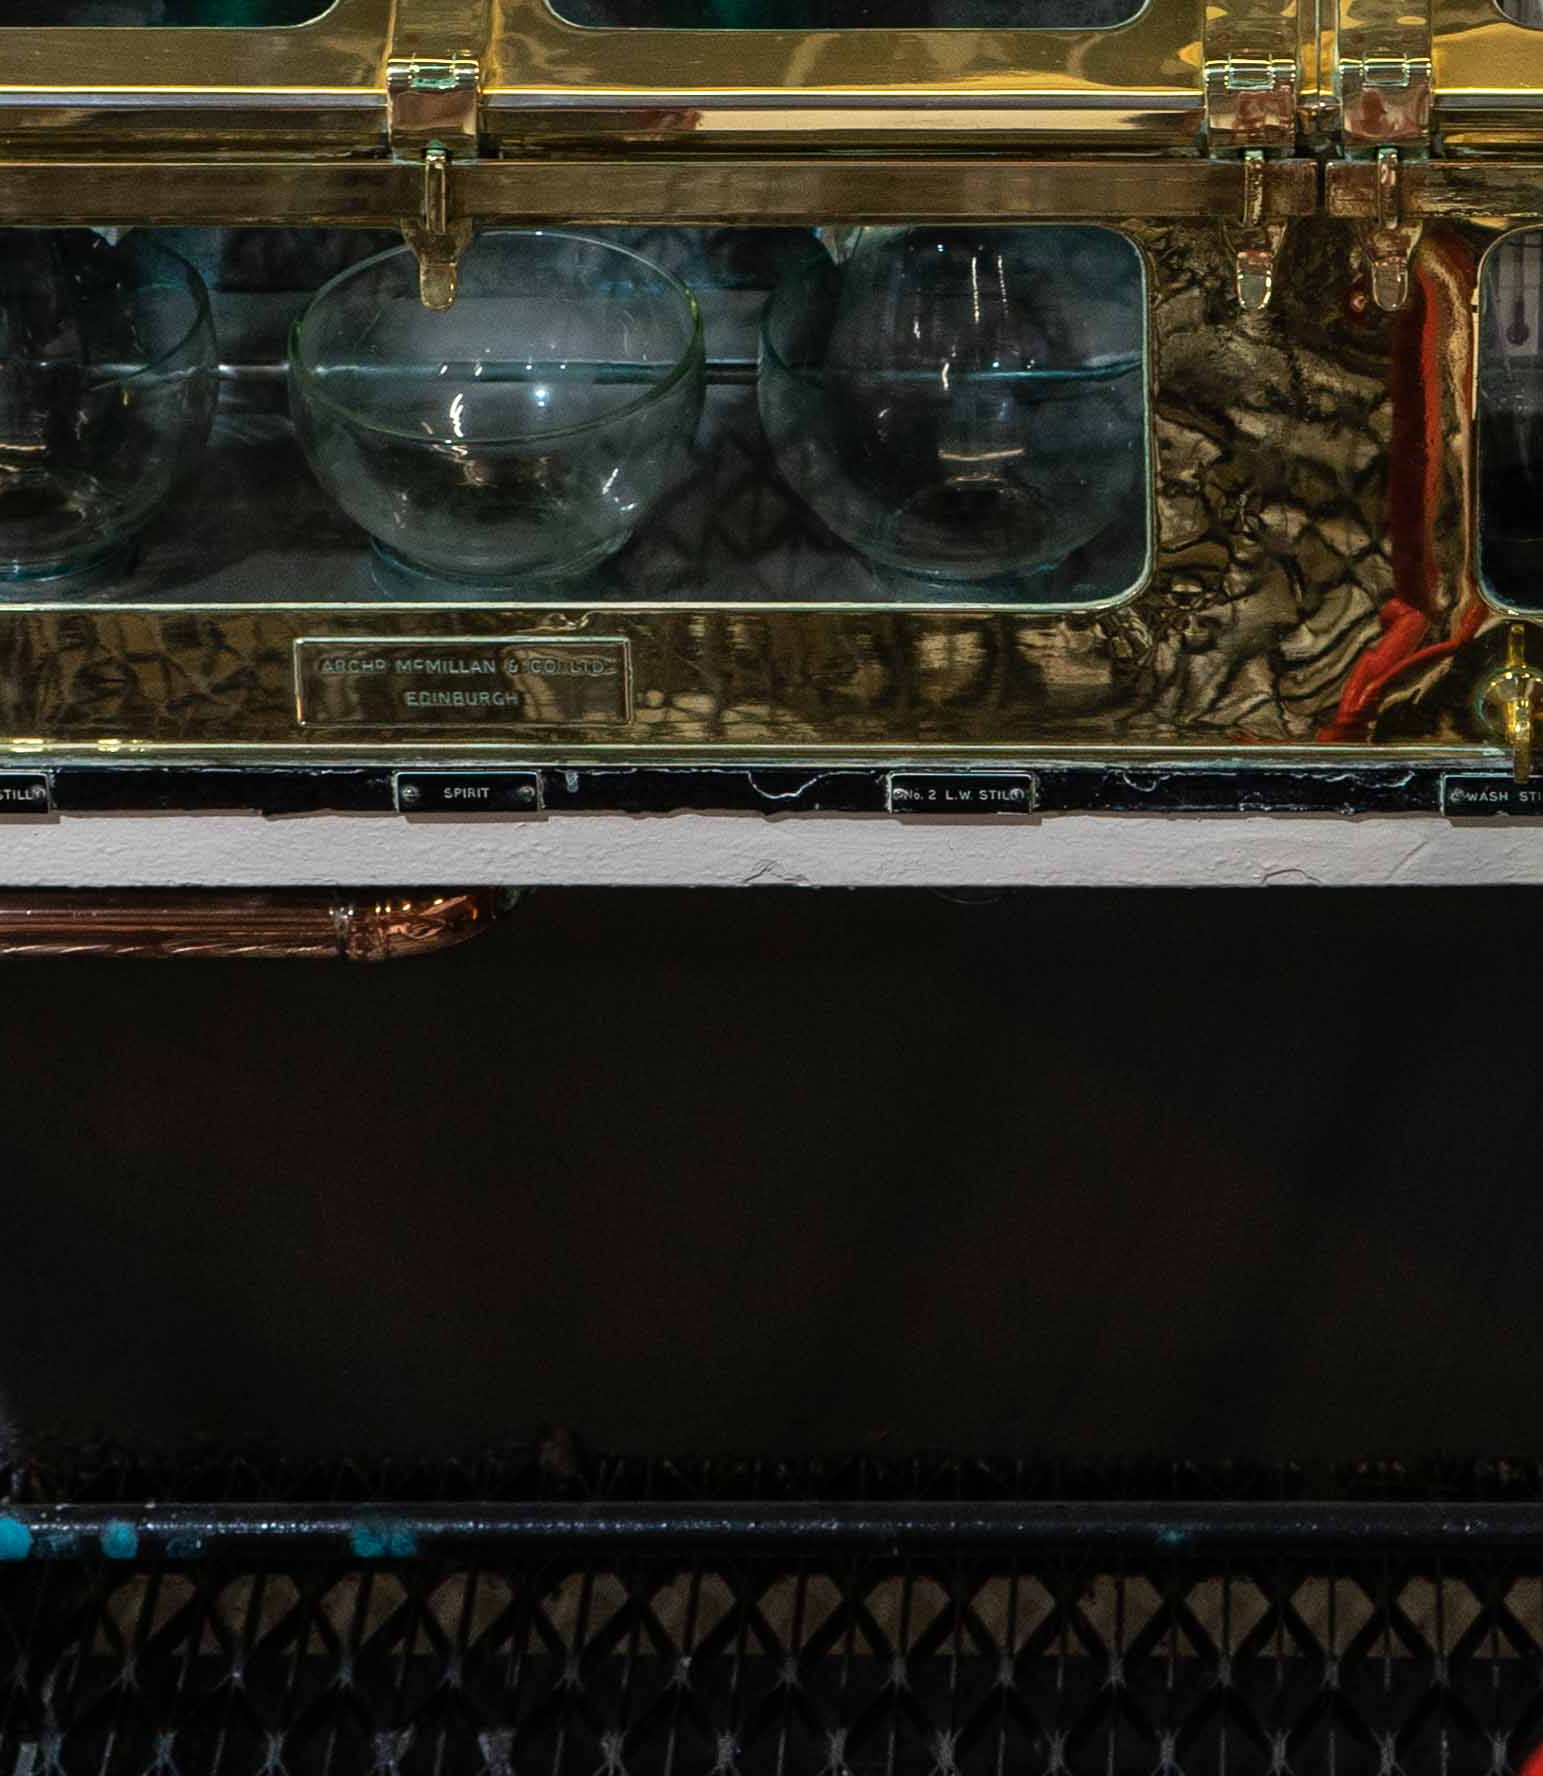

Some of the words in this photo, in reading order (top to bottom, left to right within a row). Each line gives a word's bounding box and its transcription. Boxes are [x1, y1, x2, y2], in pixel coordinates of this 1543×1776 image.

[406, 690, 520, 706] EDINBURGH
[443, 786, 490, 799] SPIRIT
[928, 789, 937, 800] 2
[978, 788, 1015, 801] STIL
[1464, 791, 1509, 803] WASH
